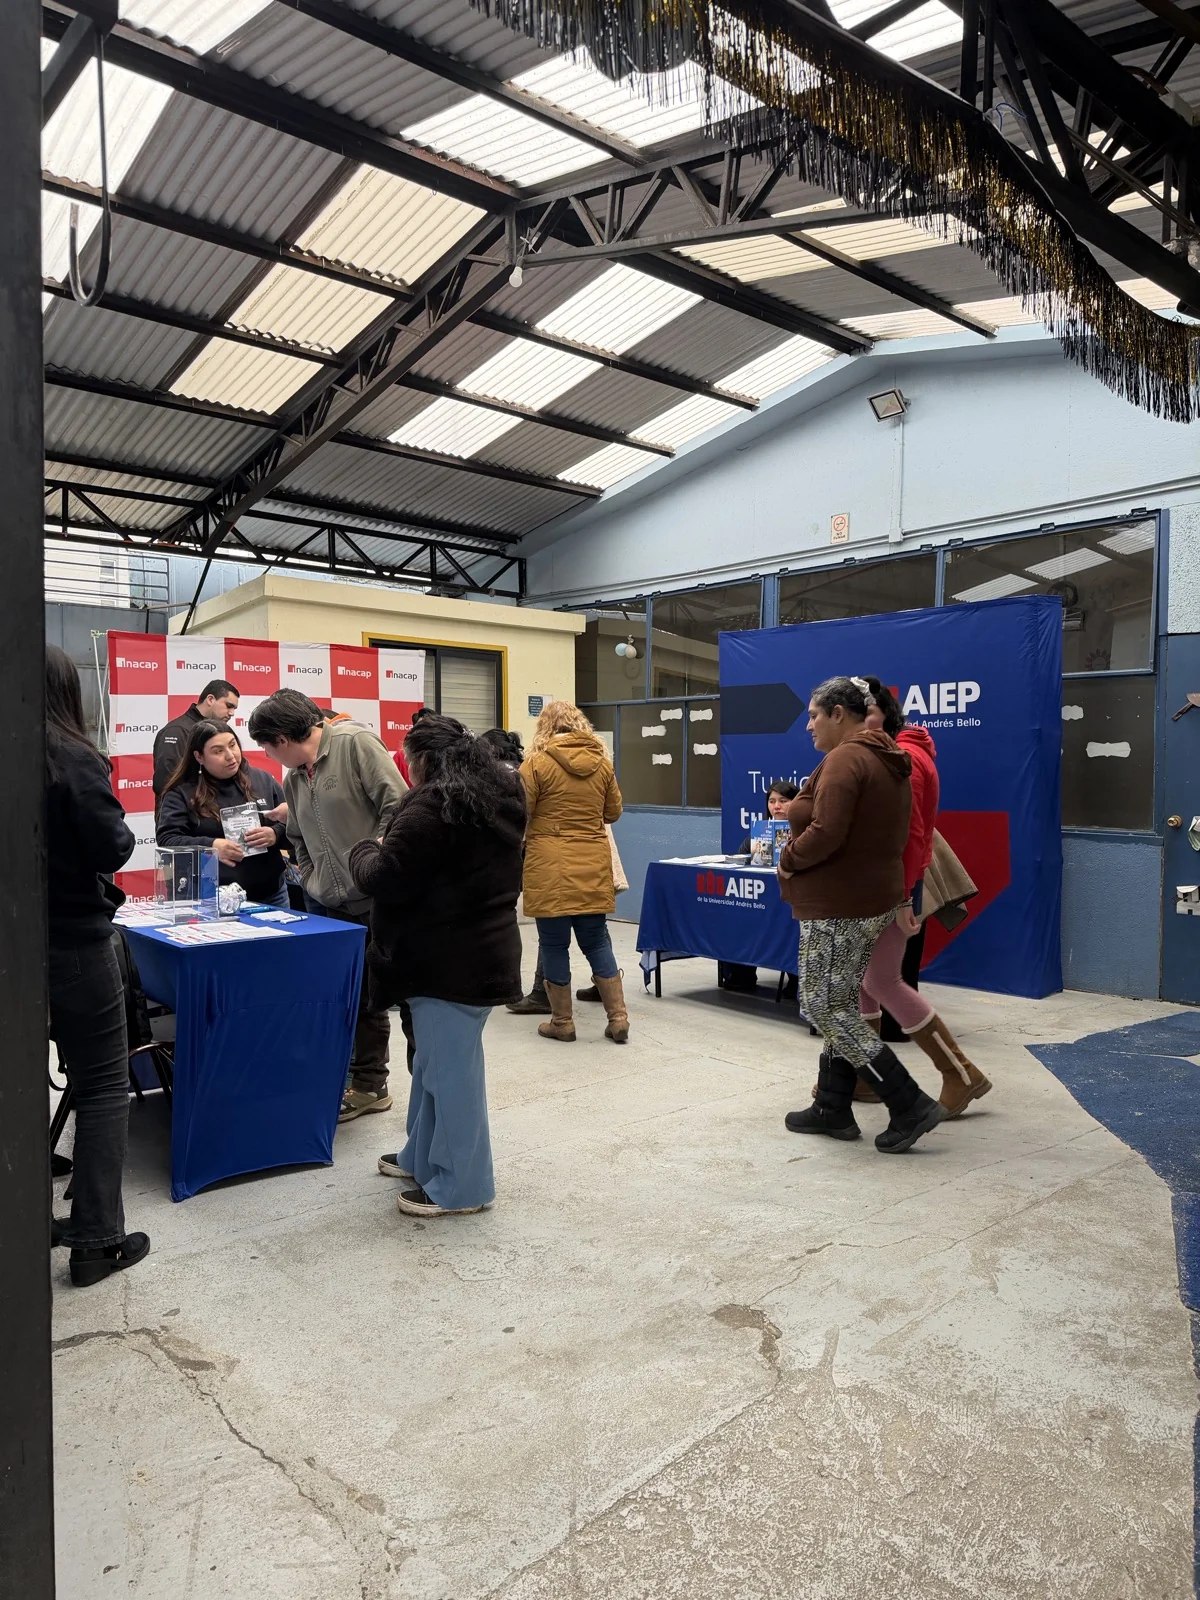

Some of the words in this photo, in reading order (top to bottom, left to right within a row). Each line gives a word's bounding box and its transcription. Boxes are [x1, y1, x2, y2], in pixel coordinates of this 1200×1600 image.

[116, 657, 159, 671] inacap
[176, 660, 217, 672] inacap
[233, 661, 272, 673] inacap
[287, 664, 323, 676] inacap
[337, 666, 372, 678] inacap
[385, 670, 418, 682] inacap
[902, 681, 981, 716] AIEP
[115, 723, 159, 733] inacap
[387, 721, 414, 730] inaca
[922, 719, 954, 728] Andrés
[957, 718, 981, 727] Bello
[118, 779, 153, 789] inaca
[748, 771, 773, 793] Tu
[725, 877, 765, 900] AIEP
[709, 898, 734, 906] Universidad
